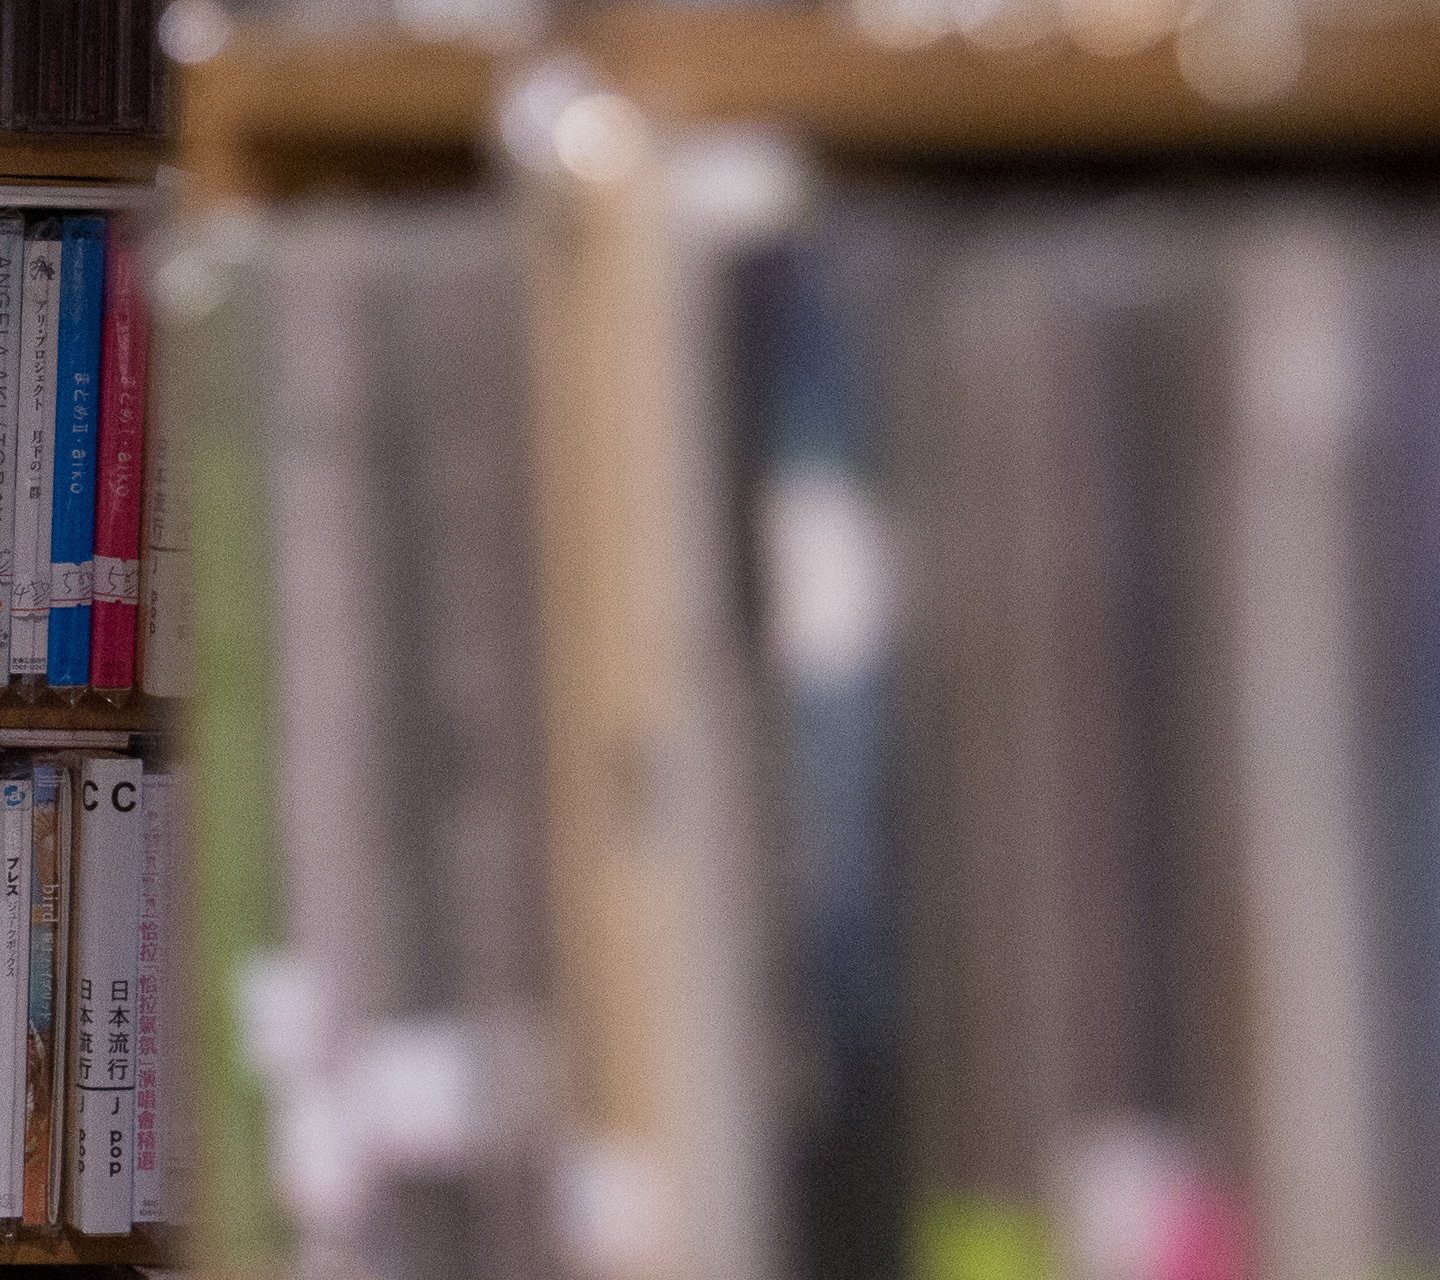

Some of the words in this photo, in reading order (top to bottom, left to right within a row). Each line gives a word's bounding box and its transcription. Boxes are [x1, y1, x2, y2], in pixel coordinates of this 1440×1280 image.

[111, 782, 136, 812] C
[6, 858, 19, 896] ブレス
[42, 883, 59, 923] bird
[107, 980, 129, 1080] 日本流行
[110, 1131, 122, 1176] pop
